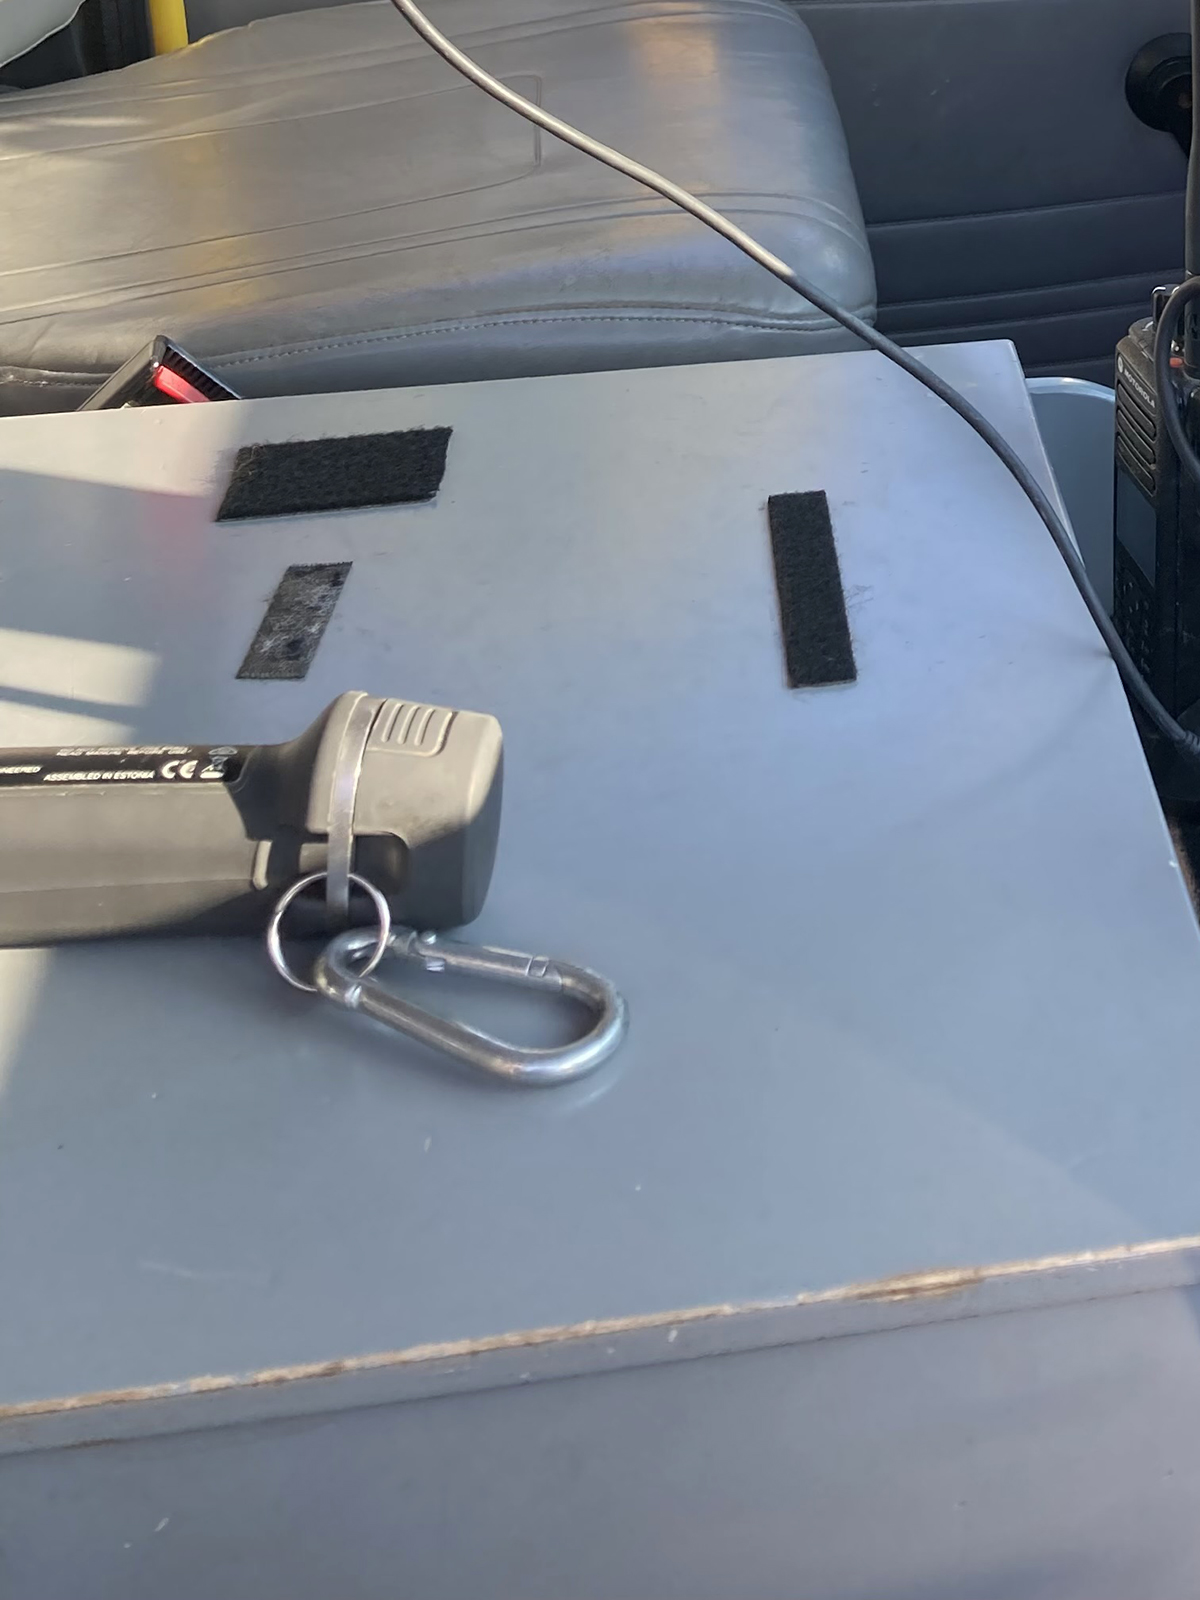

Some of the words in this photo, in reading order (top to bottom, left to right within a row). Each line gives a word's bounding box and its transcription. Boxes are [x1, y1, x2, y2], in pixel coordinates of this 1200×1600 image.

[1124, 369, 1156, 408] MOTOROLA
[43, 773, 101, 781] ASSEMBLED
[101, 772, 113, 780] IN
[114, 770, 155, 780] ESTONIA
